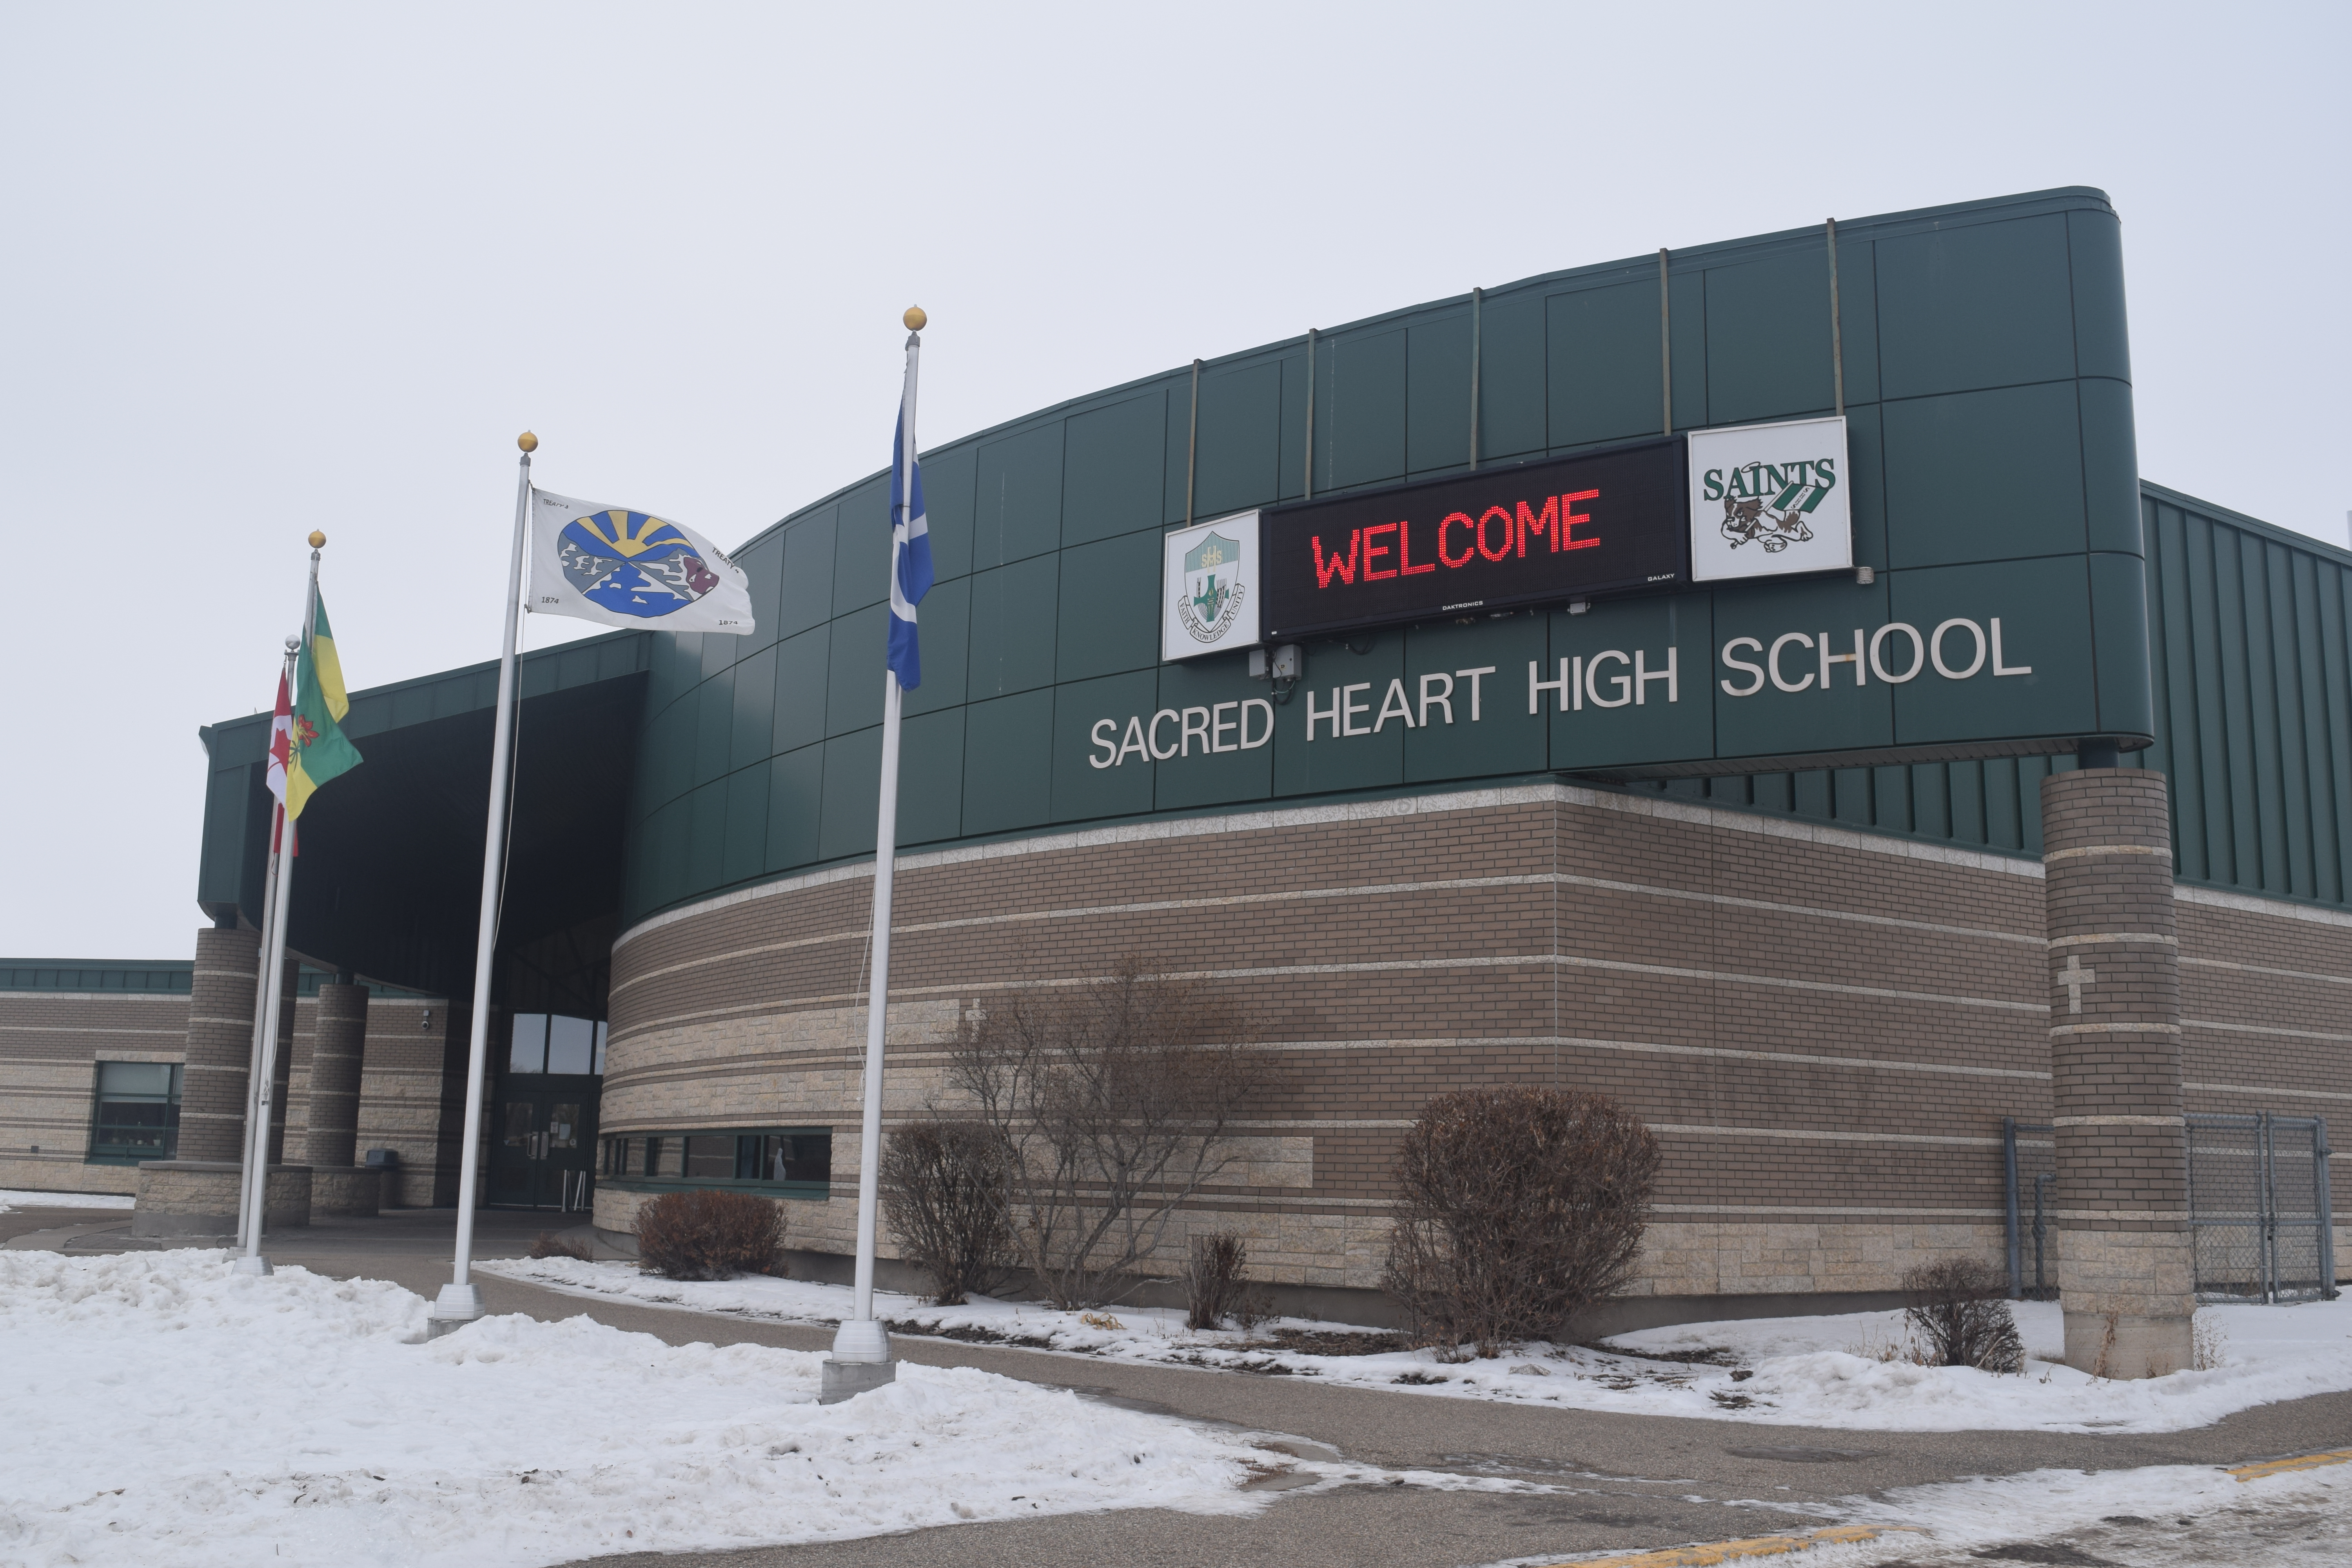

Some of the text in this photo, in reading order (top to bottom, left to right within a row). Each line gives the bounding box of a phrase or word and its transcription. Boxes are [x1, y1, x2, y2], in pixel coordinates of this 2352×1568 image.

[1703, 458, 1836, 501] SAINTS
[1791, 487, 1810, 509] SHHS
[1311, 488, 1600, 589] WELCOME
[712, 546, 735, 569] TREATY
[1648, 573, 1675, 582] GALAXY
[1231, 588, 1243, 615] UNITY
[1442, 601, 1483, 611] DAKTRONICS
[1180, 602, 1191, 625] FAITH
[1192, 622, 1229, 641] KNOWLEDGE
[1089, 617, 2032, 769] SACRED HEART HIGH SCHOOL
